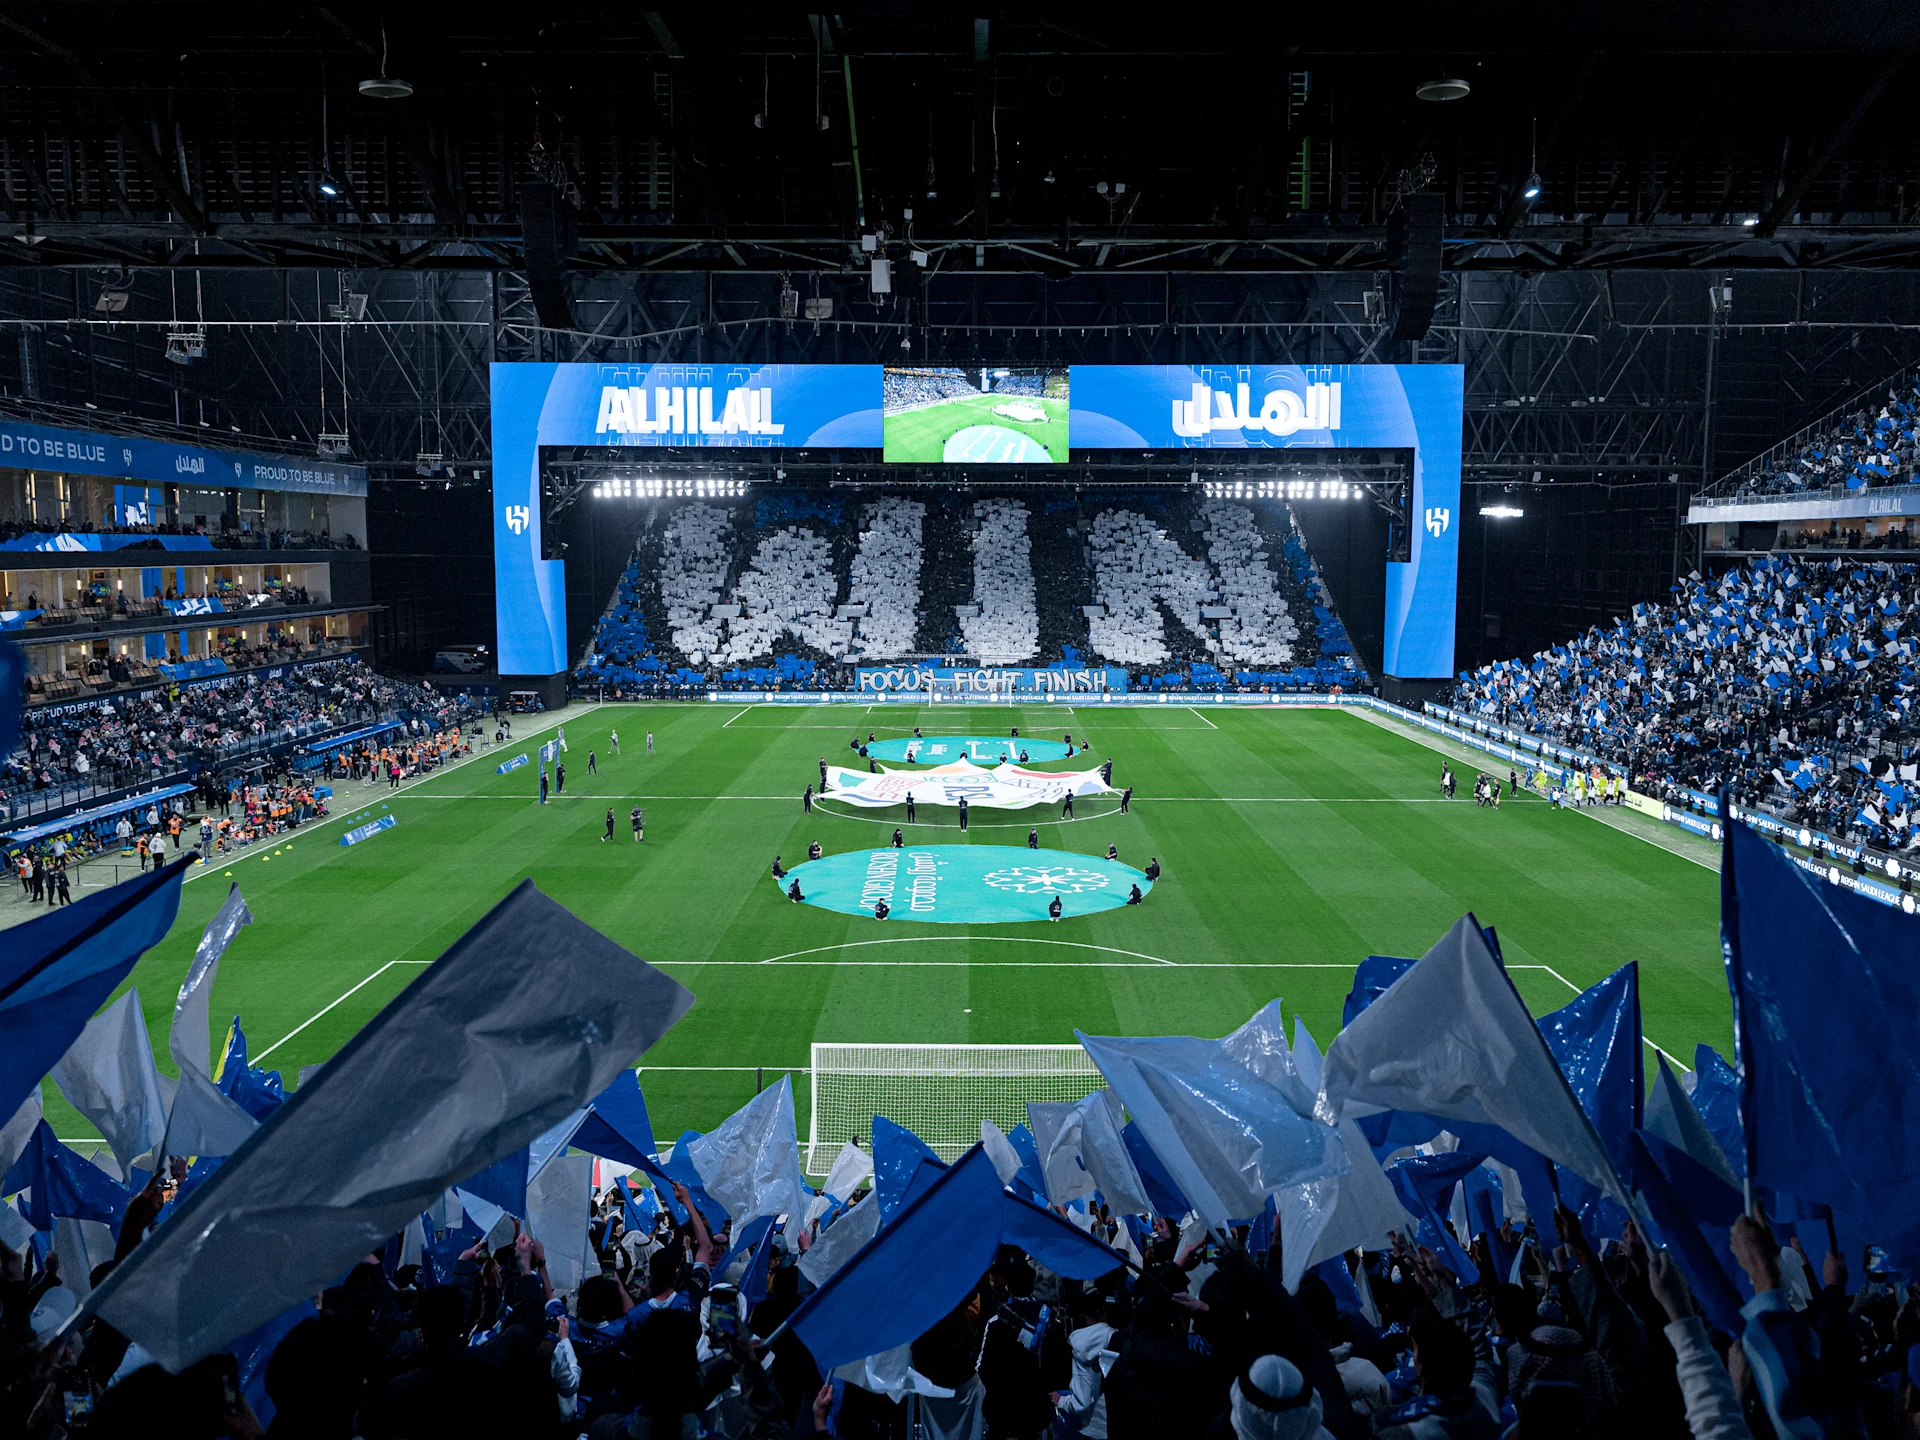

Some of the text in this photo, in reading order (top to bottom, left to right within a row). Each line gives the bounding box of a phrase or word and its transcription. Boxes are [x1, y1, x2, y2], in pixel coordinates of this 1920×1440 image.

[595, 386, 785, 435] ALHILAL
[1172, 382, 1342, 437] الهلال
[17, 436, 40, 455] TO
[43, 440, 65, 458] BE
[67, 443, 106, 462] BLUE
[175, 455, 205, 474] الهلال
[254, 465, 336, 485] PROUD TO BE BLUE
[1869, 498, 1903, 514] ALHILAL
[64, 705, 77, 714] TO
[1758, 818, 1775, 831] SAUDI
[1836, 844, 1856, 858] SAUDI
[865, 851, 899, 879] ROSHN
[906, 851, 949, 875] روشن
[1808, 862, 1828, 878] LEAGUE
[1840, 875, 1901, 906] ROSHN SAUDI LEAGUE
